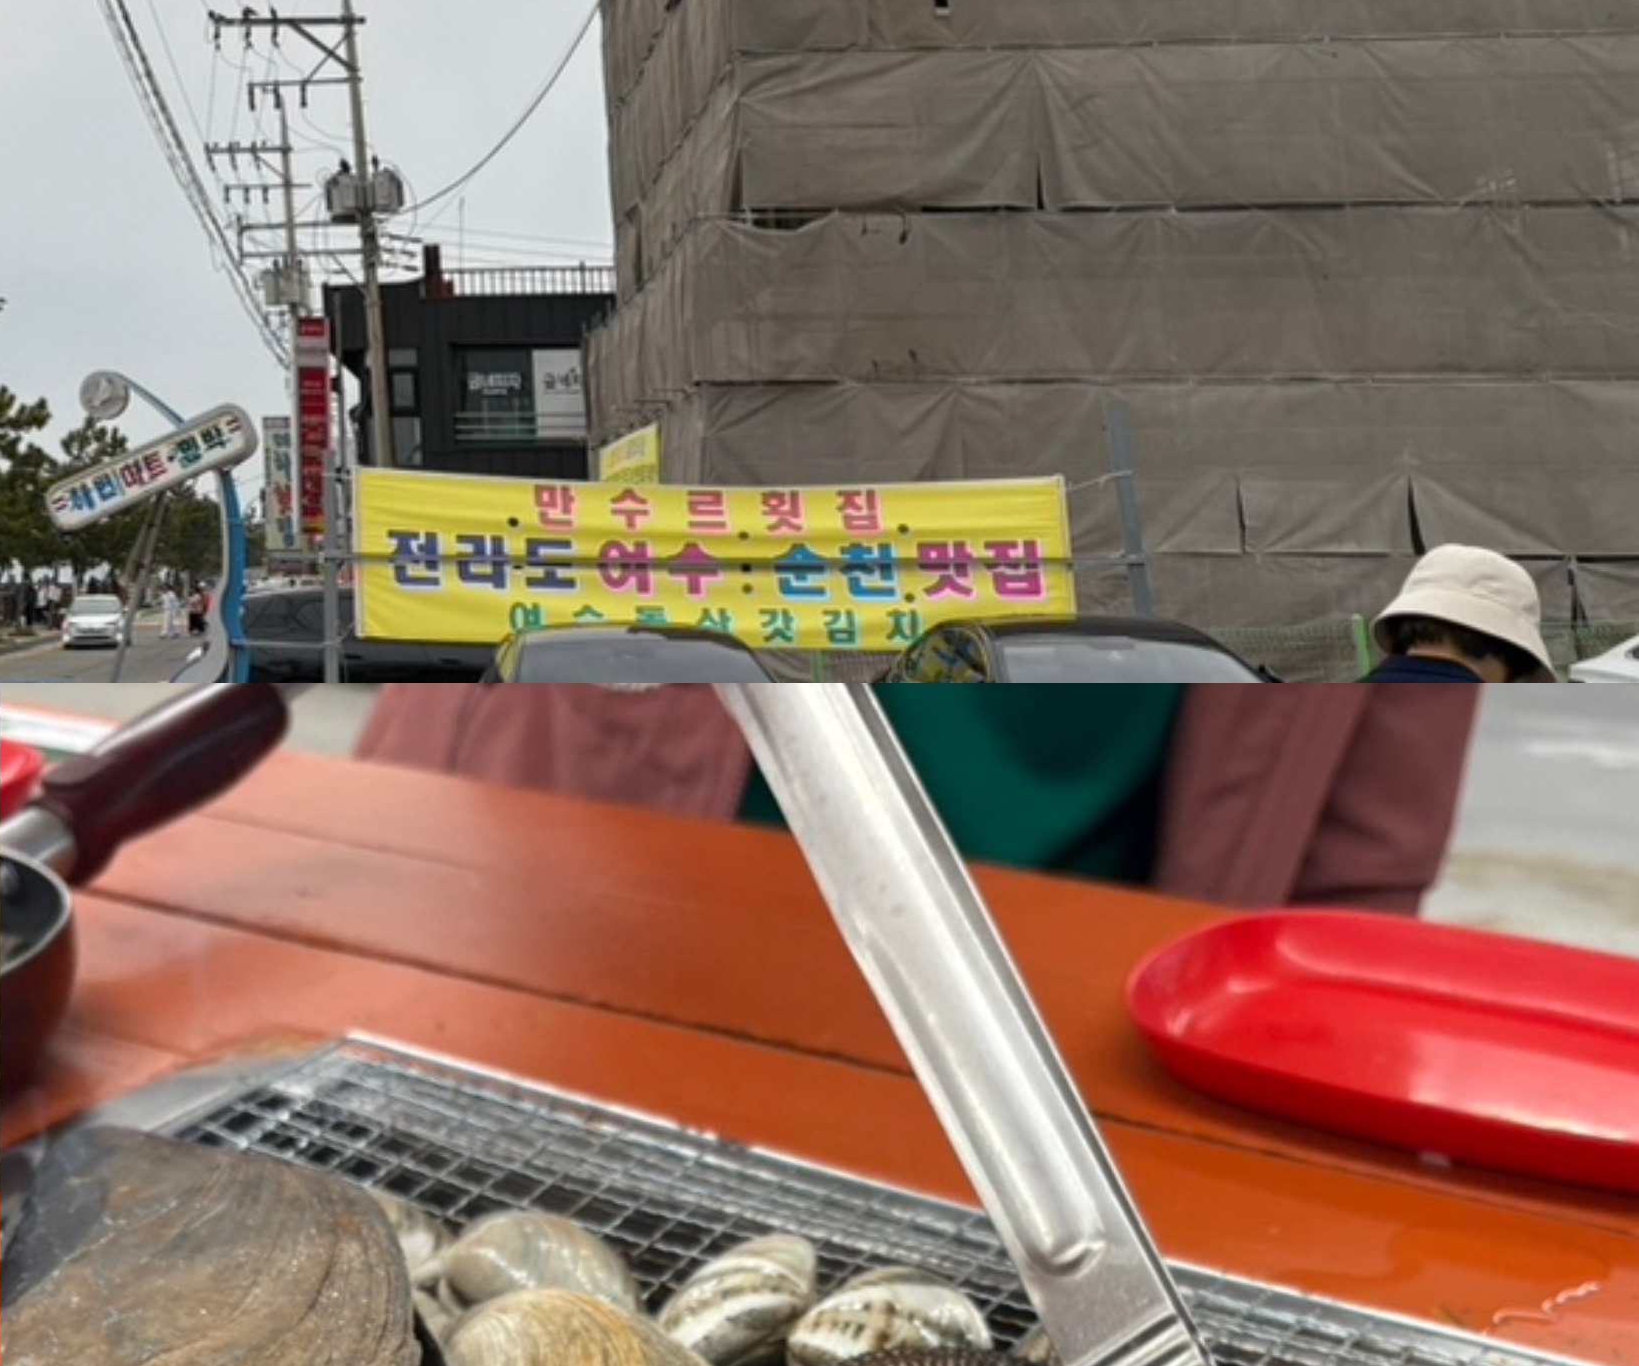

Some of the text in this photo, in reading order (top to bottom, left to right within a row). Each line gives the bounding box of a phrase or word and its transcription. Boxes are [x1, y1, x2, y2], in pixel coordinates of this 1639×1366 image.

[534, 484, 885, 534] 만수르횟집
[385, 529, 1046, 600] 전라도 여수 순천 맛집
